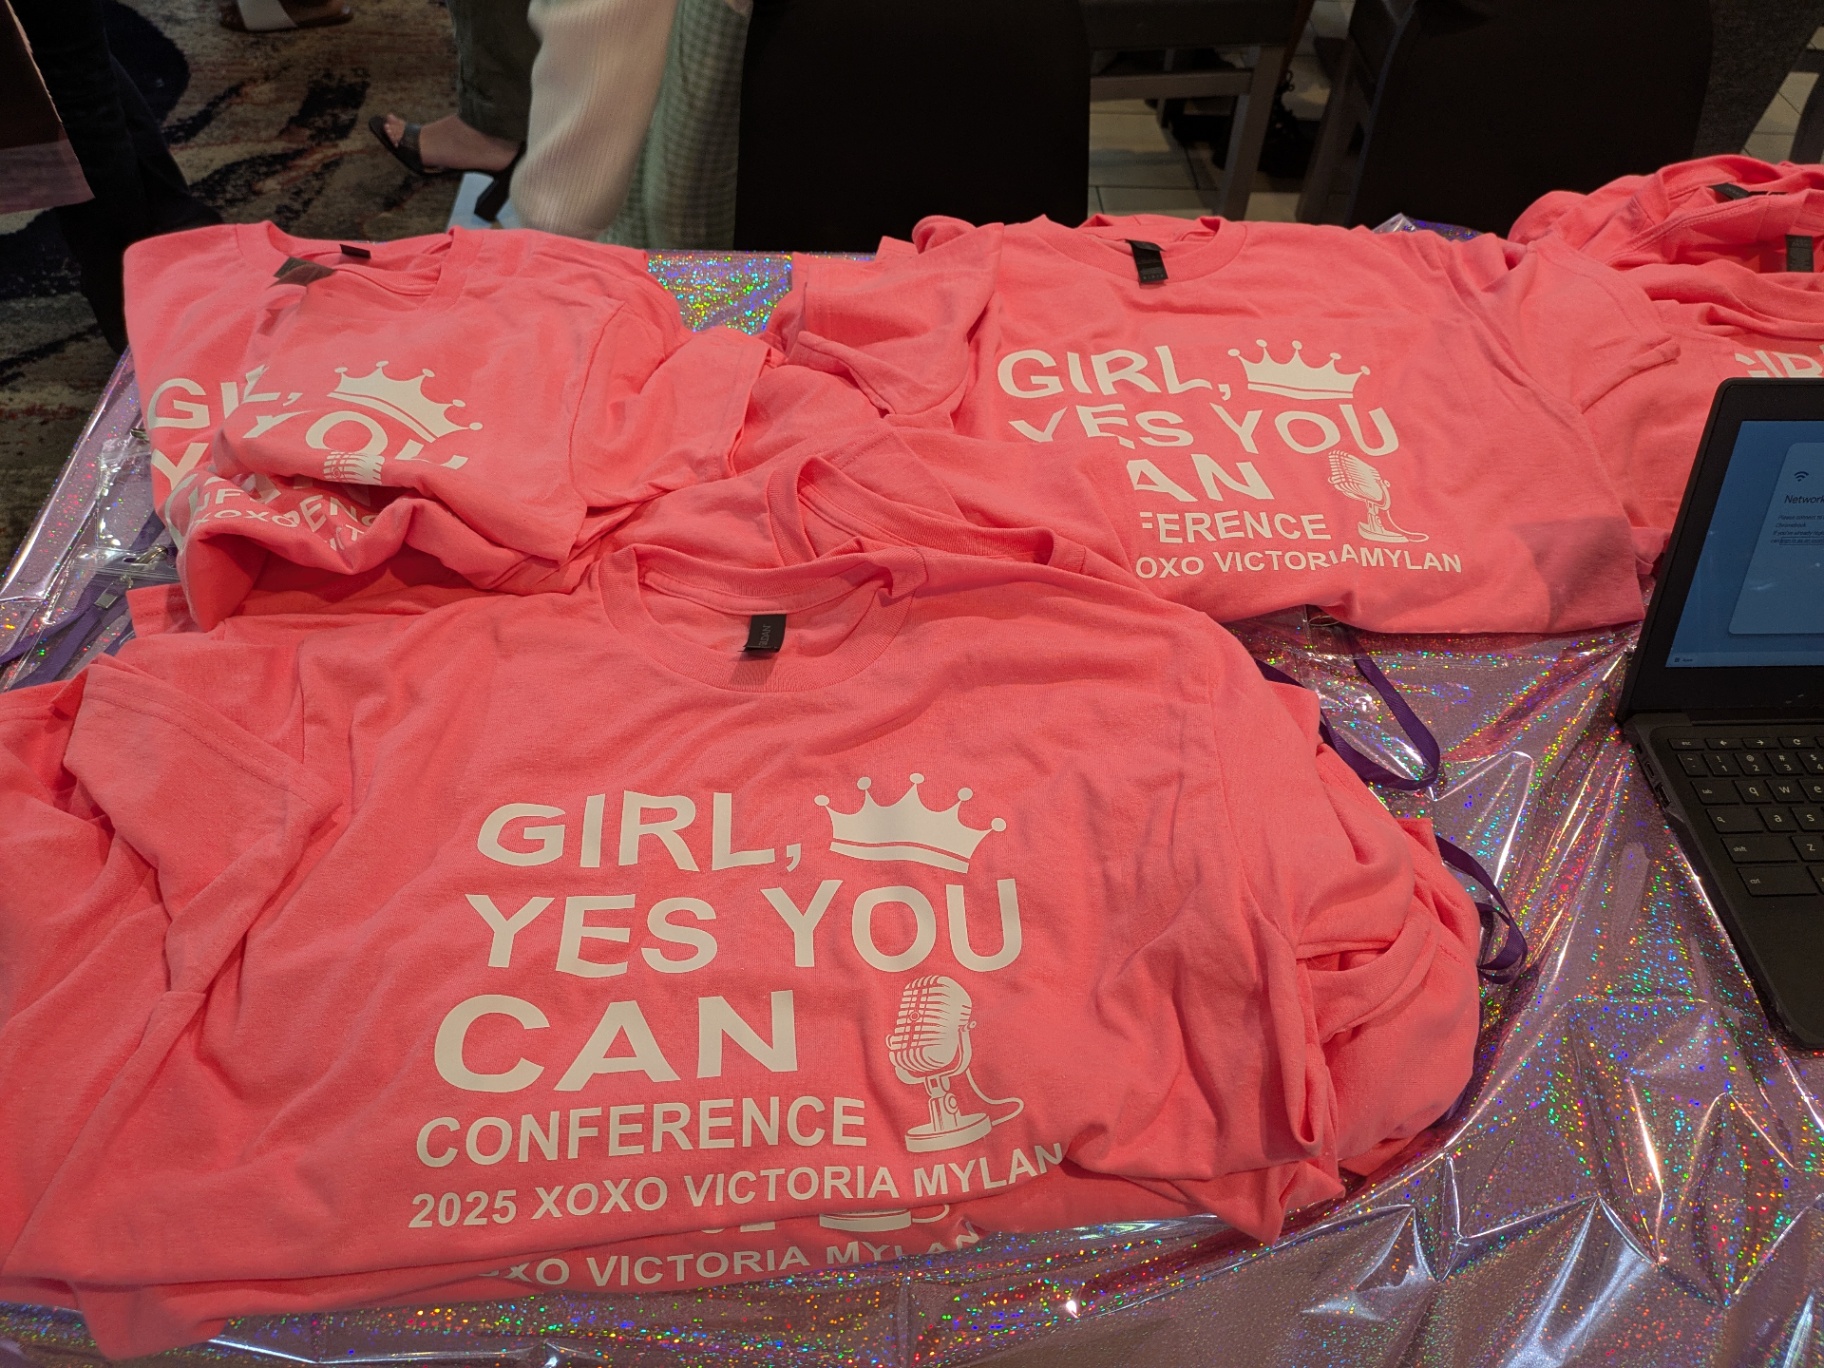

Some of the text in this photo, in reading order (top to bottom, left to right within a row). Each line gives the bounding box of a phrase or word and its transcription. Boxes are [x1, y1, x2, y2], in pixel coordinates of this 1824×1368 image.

[998, 344, 1232, 401] GIRL,
[1209, 402, 1400, 457] YOU
[1360, 547, 1462, 573] MYLAN
[476, 790, 802, 873] GIRL,
[464, 878, 1023, 979] YES YOU
[433, 989, 799, 1093] CAN
[416, 1096, 867, 1168] CONFERENCE
[408, 1142, 1063, 1229] 2025 XOXO VICTORIA MYLAN
[586, 1245, 811, 1287] VICTORIA
